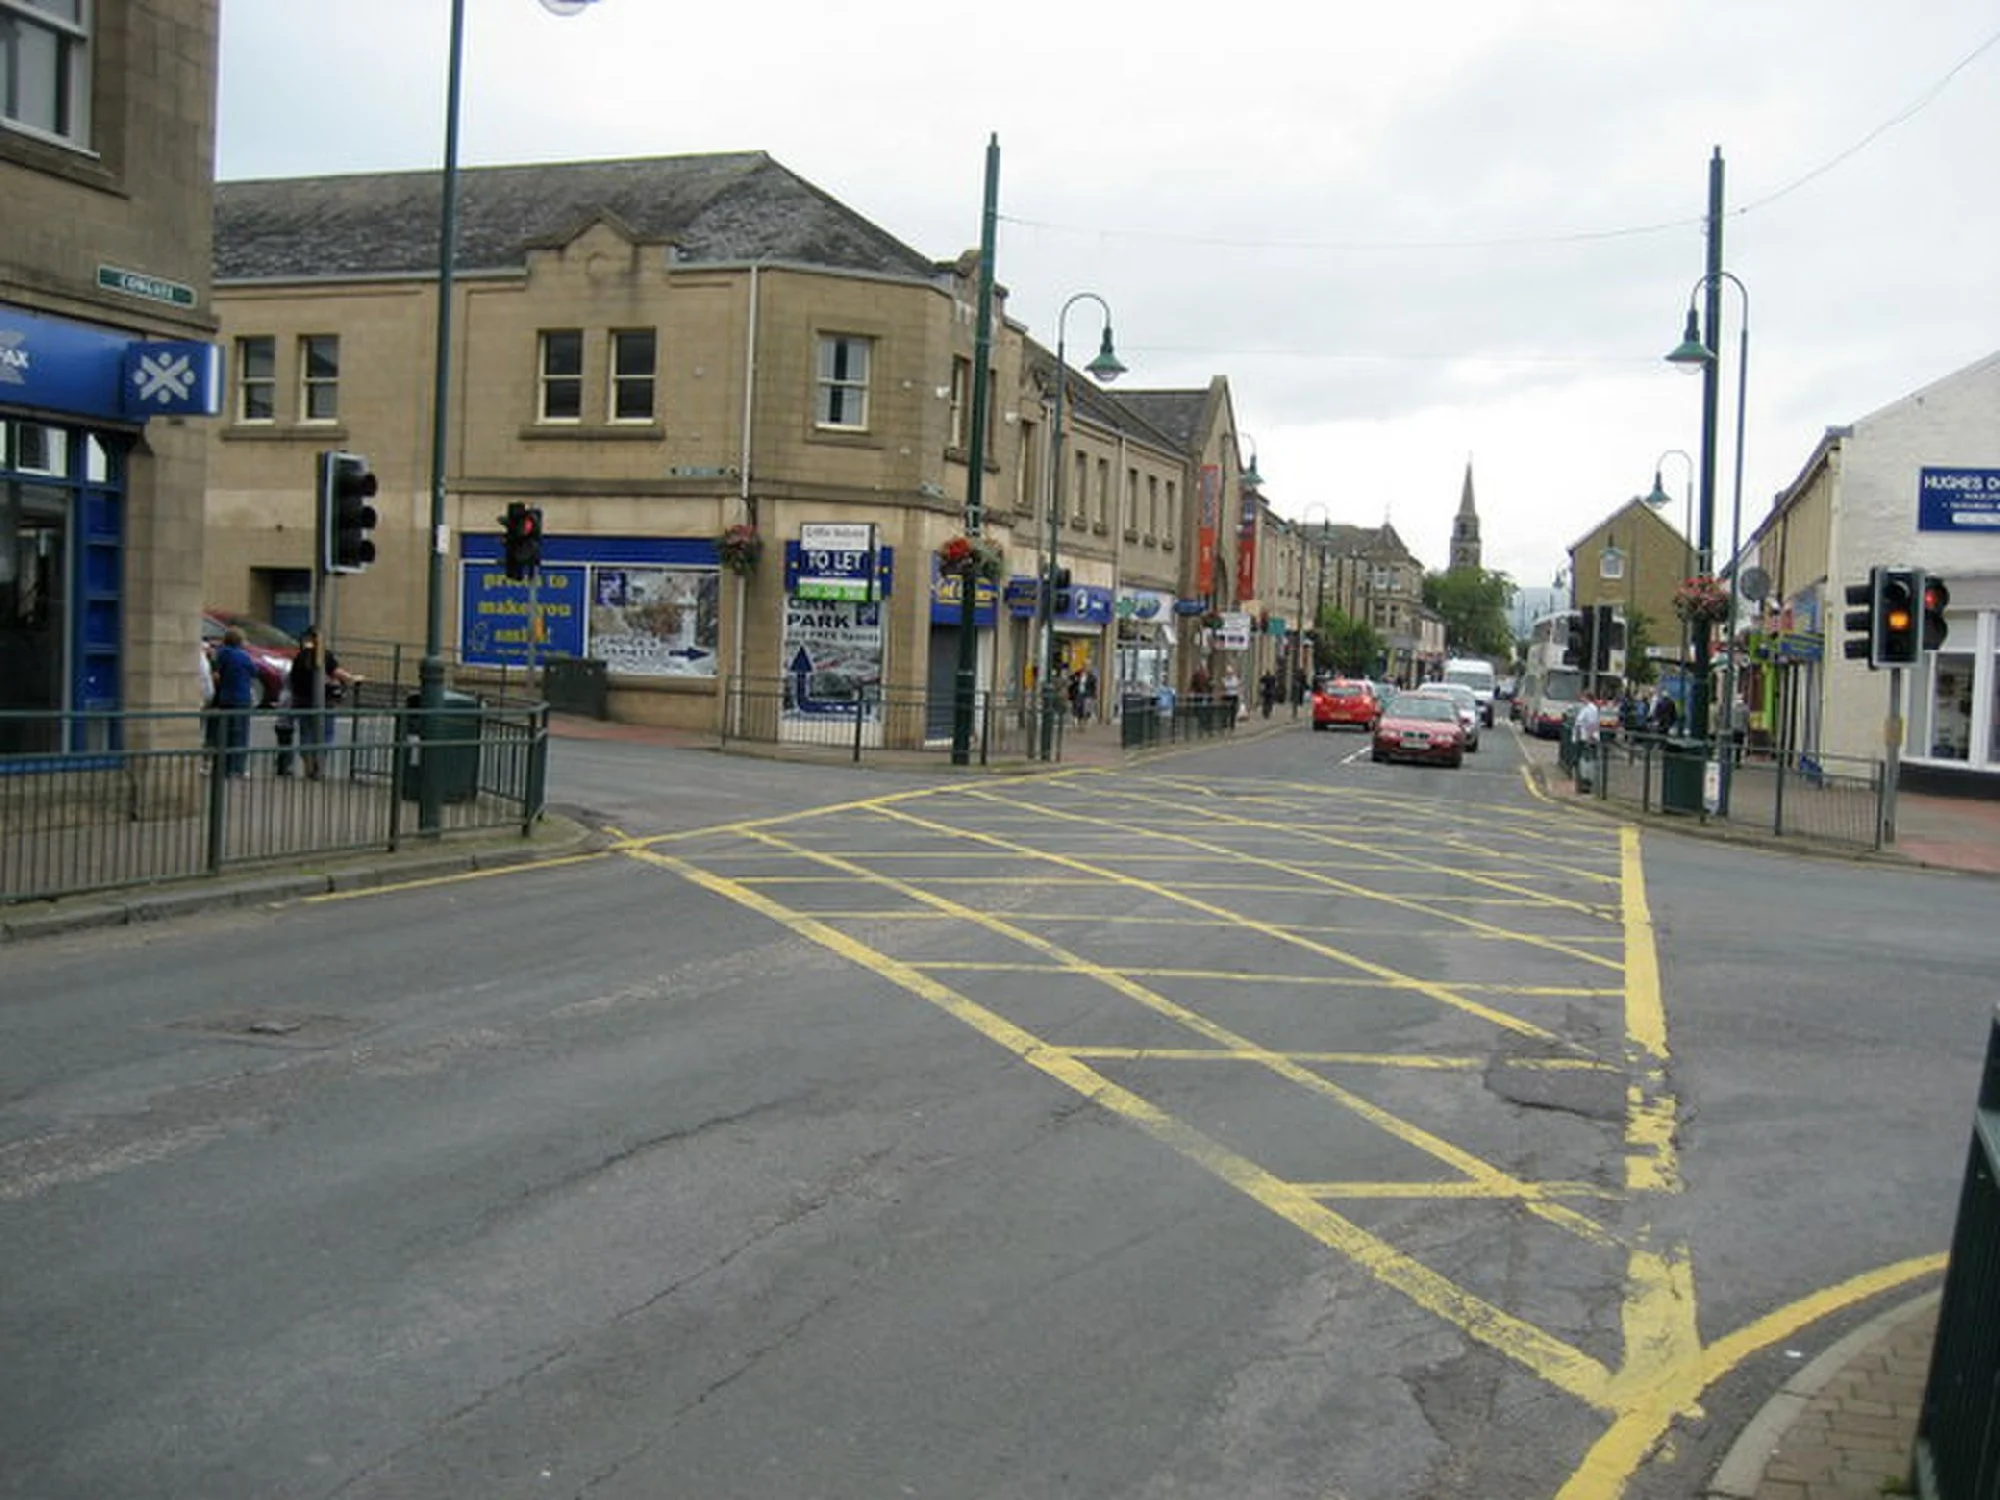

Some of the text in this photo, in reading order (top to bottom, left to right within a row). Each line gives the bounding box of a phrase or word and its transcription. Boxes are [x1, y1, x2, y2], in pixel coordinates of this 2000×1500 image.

[1924, 475, 1983, 490] HUGHES
[809, 551, 863, 570] TO LET
[787, 612, 850, 629] PARK
